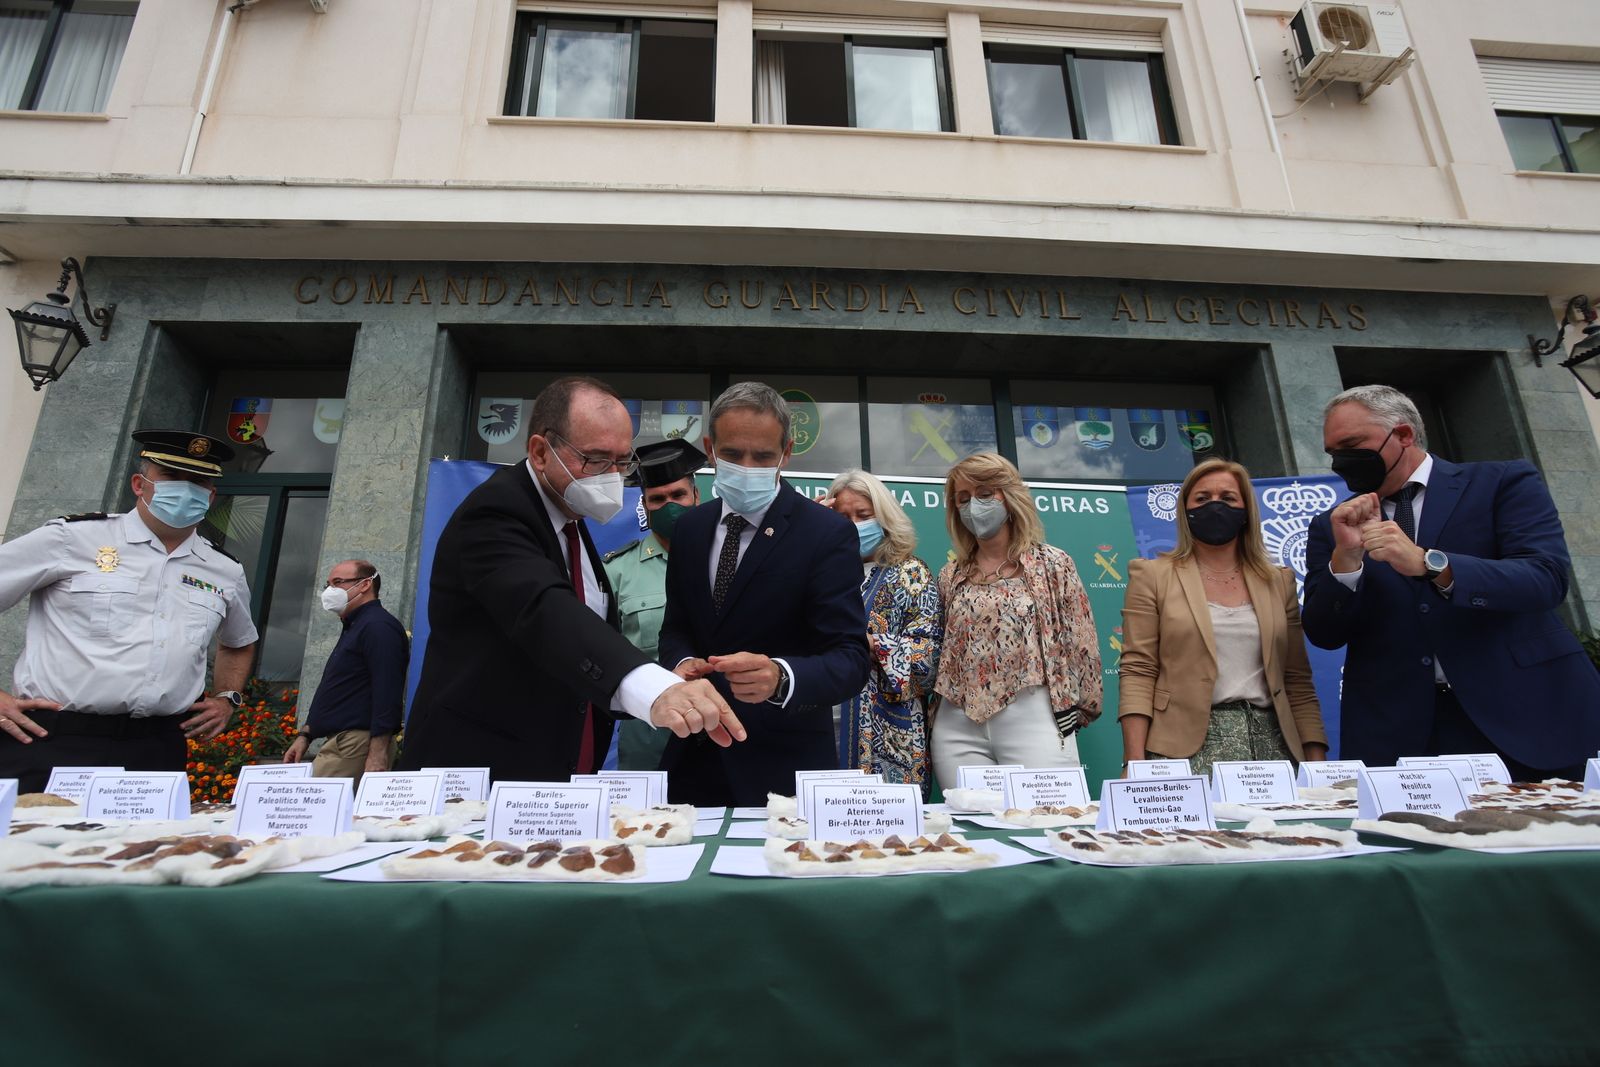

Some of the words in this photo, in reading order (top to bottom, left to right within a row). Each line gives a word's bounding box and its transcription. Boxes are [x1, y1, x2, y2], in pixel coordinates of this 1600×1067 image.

[294, 272, 672, 308] COMANDANCIA
[703, 279, 926, 314] GUARDIA
[952, 286, 1082, 320] CIVIL
[1112, 292, 1368, 331] ALGECIRAS
[1034, 495, 1110, 514] CIRAS
[1397, 773, 1427, 781] -Hachas-
[136, 787, 164, 795] Superior
[264, 786, 293, 794] -Puntas
[295, 786, 325, 794] flechas-
[1123, 784, 1191, 794] -Punzones-Buriles-
[532, 790, 566, 799] -Buriles-
[303, 796, 326, 805] Medio
[871, 797, 906, 805] Superior
[1133, 795, 1184, 804] Levalloisiense
[554, 801, 589, 810] Superior
[1138, 804, 1182, 814] Tilemsi-Gao
[1405, 803, 1442, 811] Marruecos
[847, 807, 885, 816] Ateriense
[875, 817, 905, 828] Argelia
[1174, 815, 1182, 823] R.
[1184, 814, 1200, 823] Mali
[267, 821, 308, 829] Marruecos
[508, 827, 523, 836] Sur
[525, 828, 535, 836] de
[537, 827, 582, 836] Mauritania
